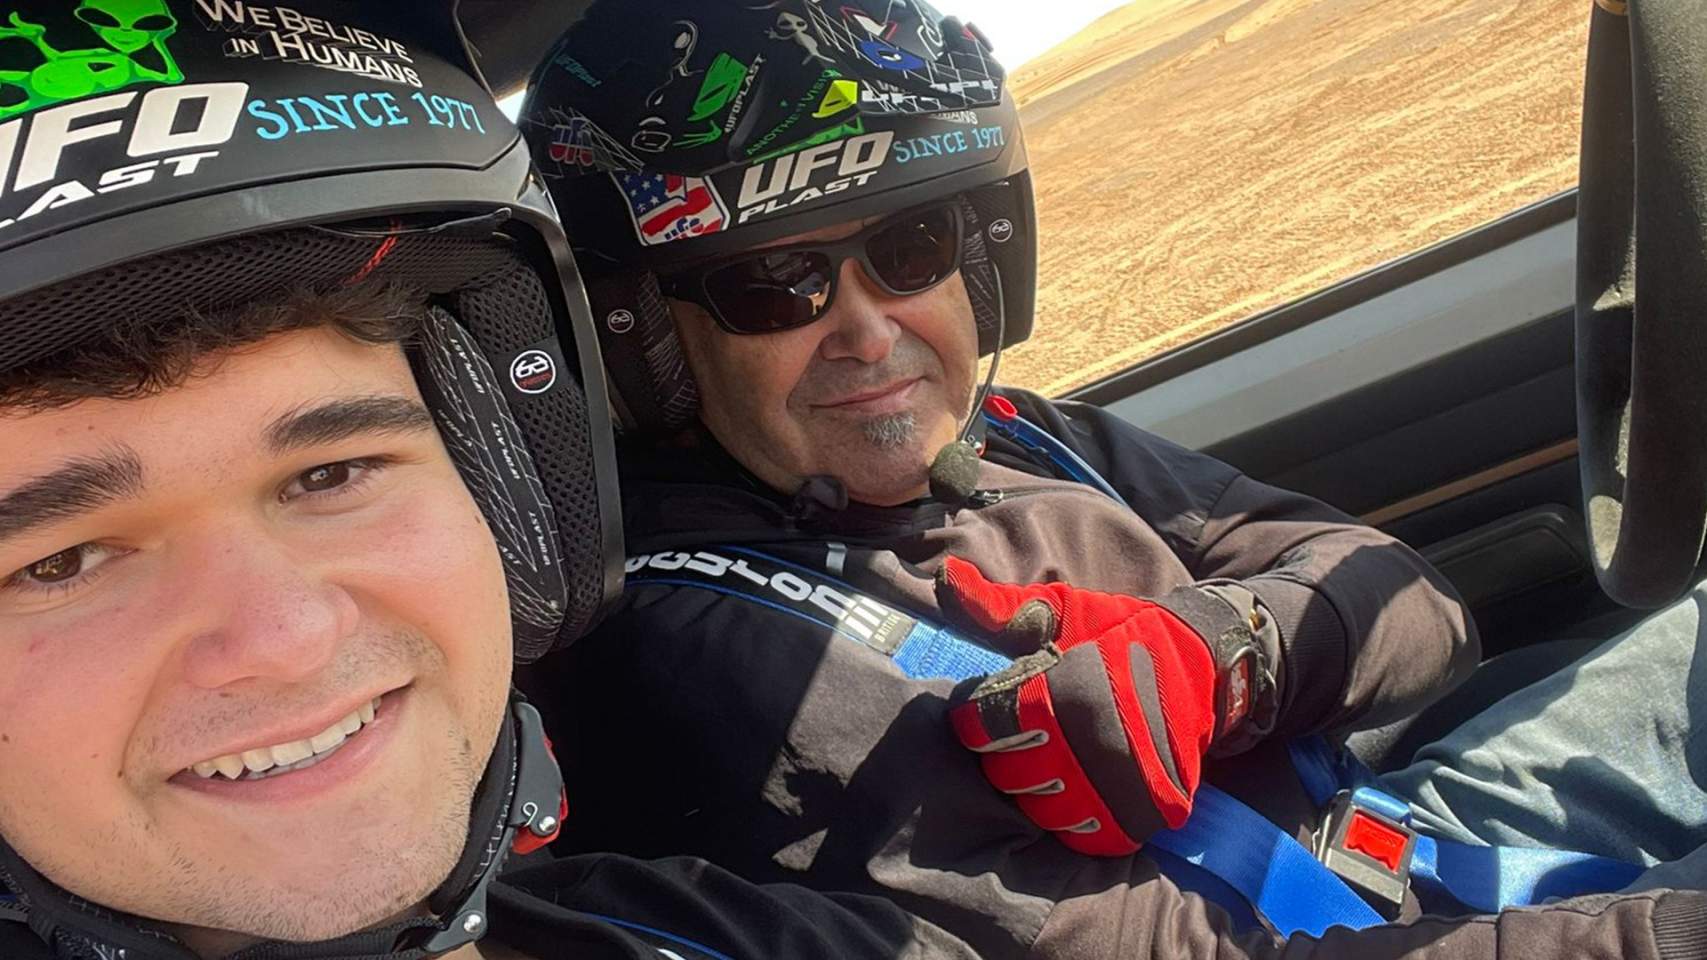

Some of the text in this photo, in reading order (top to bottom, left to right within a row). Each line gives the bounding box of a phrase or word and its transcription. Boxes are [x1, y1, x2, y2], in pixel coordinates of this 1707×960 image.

[270, 31, 423, 88] HUMANS
[276, 6, 414, 64] BELIEVE
[248, 92, 486, 140] SINCE 1977
[737, 130, 894, 209] UFO
[892, 126, 1005, 163] SINCE 1977
[738, 170, 878, 225] PLAST
